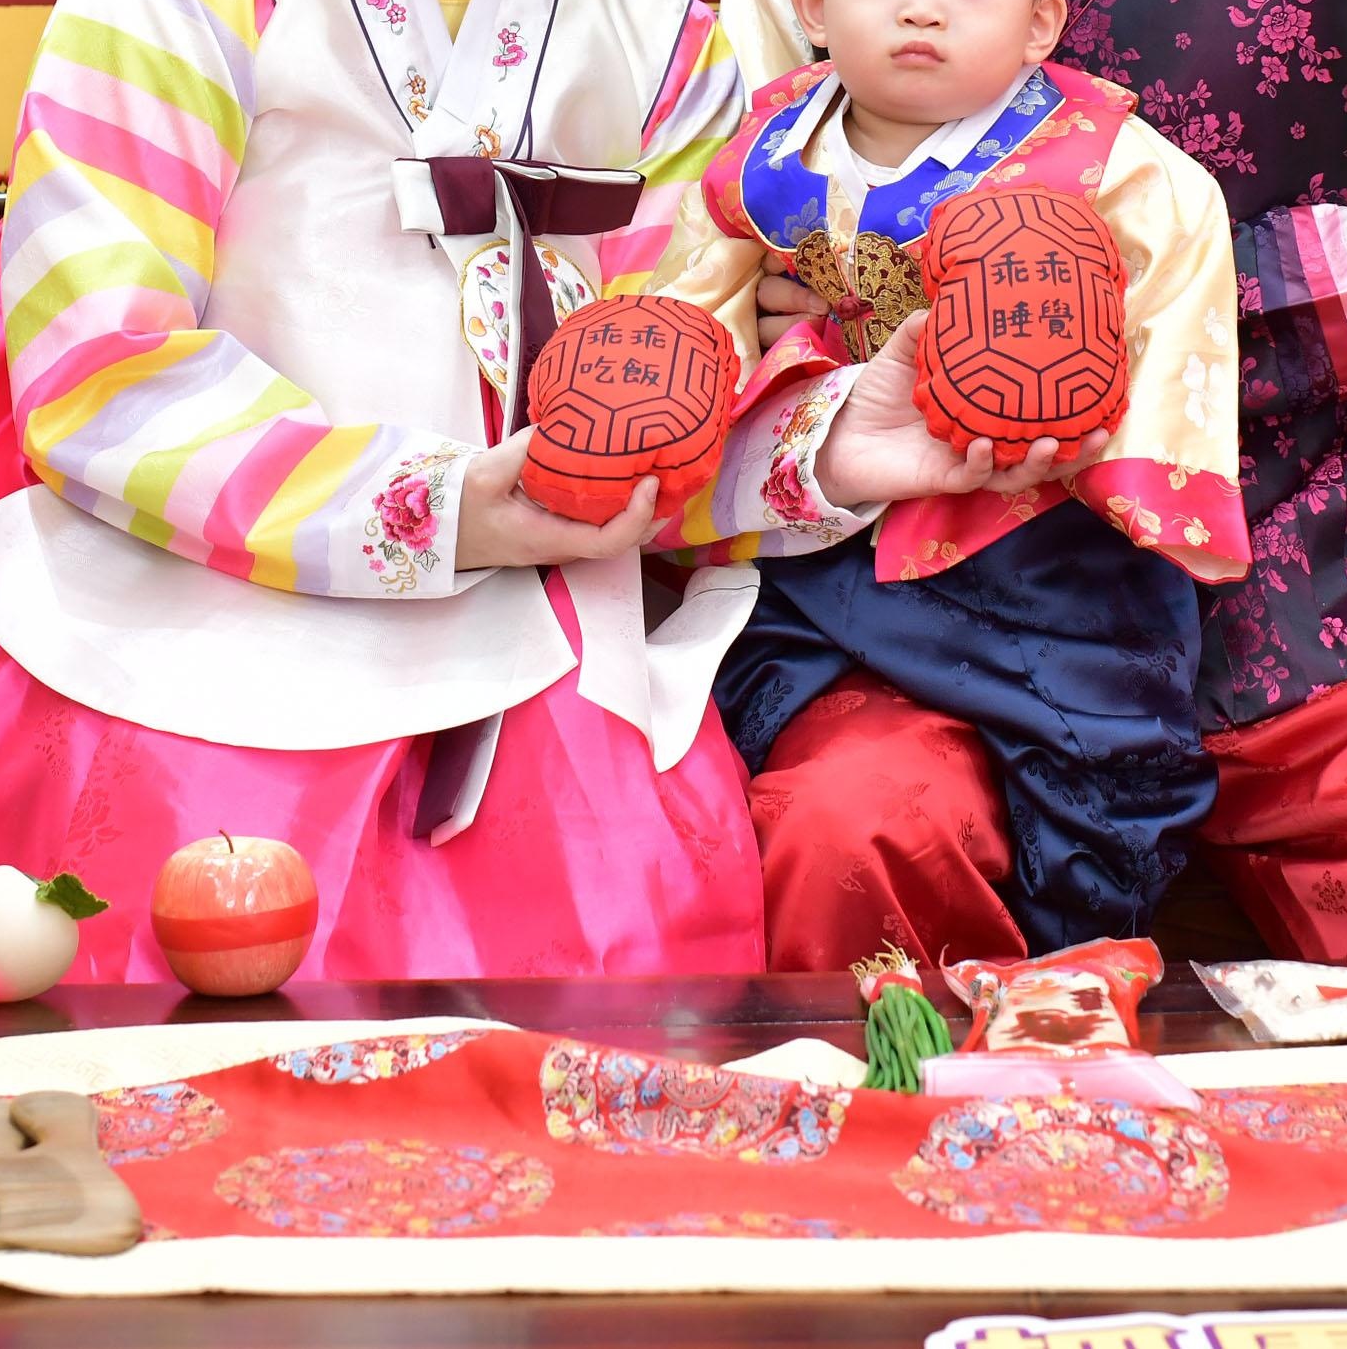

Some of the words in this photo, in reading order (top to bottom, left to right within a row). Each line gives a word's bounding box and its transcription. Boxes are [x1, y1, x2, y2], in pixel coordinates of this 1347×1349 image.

[989, 250, 1072, 286] 乖乖
[586, 322, 667, 348] 乖乖
[991, 299, 1075, 341] 睡覺
[579, 359, 661, 389] 吃飯
